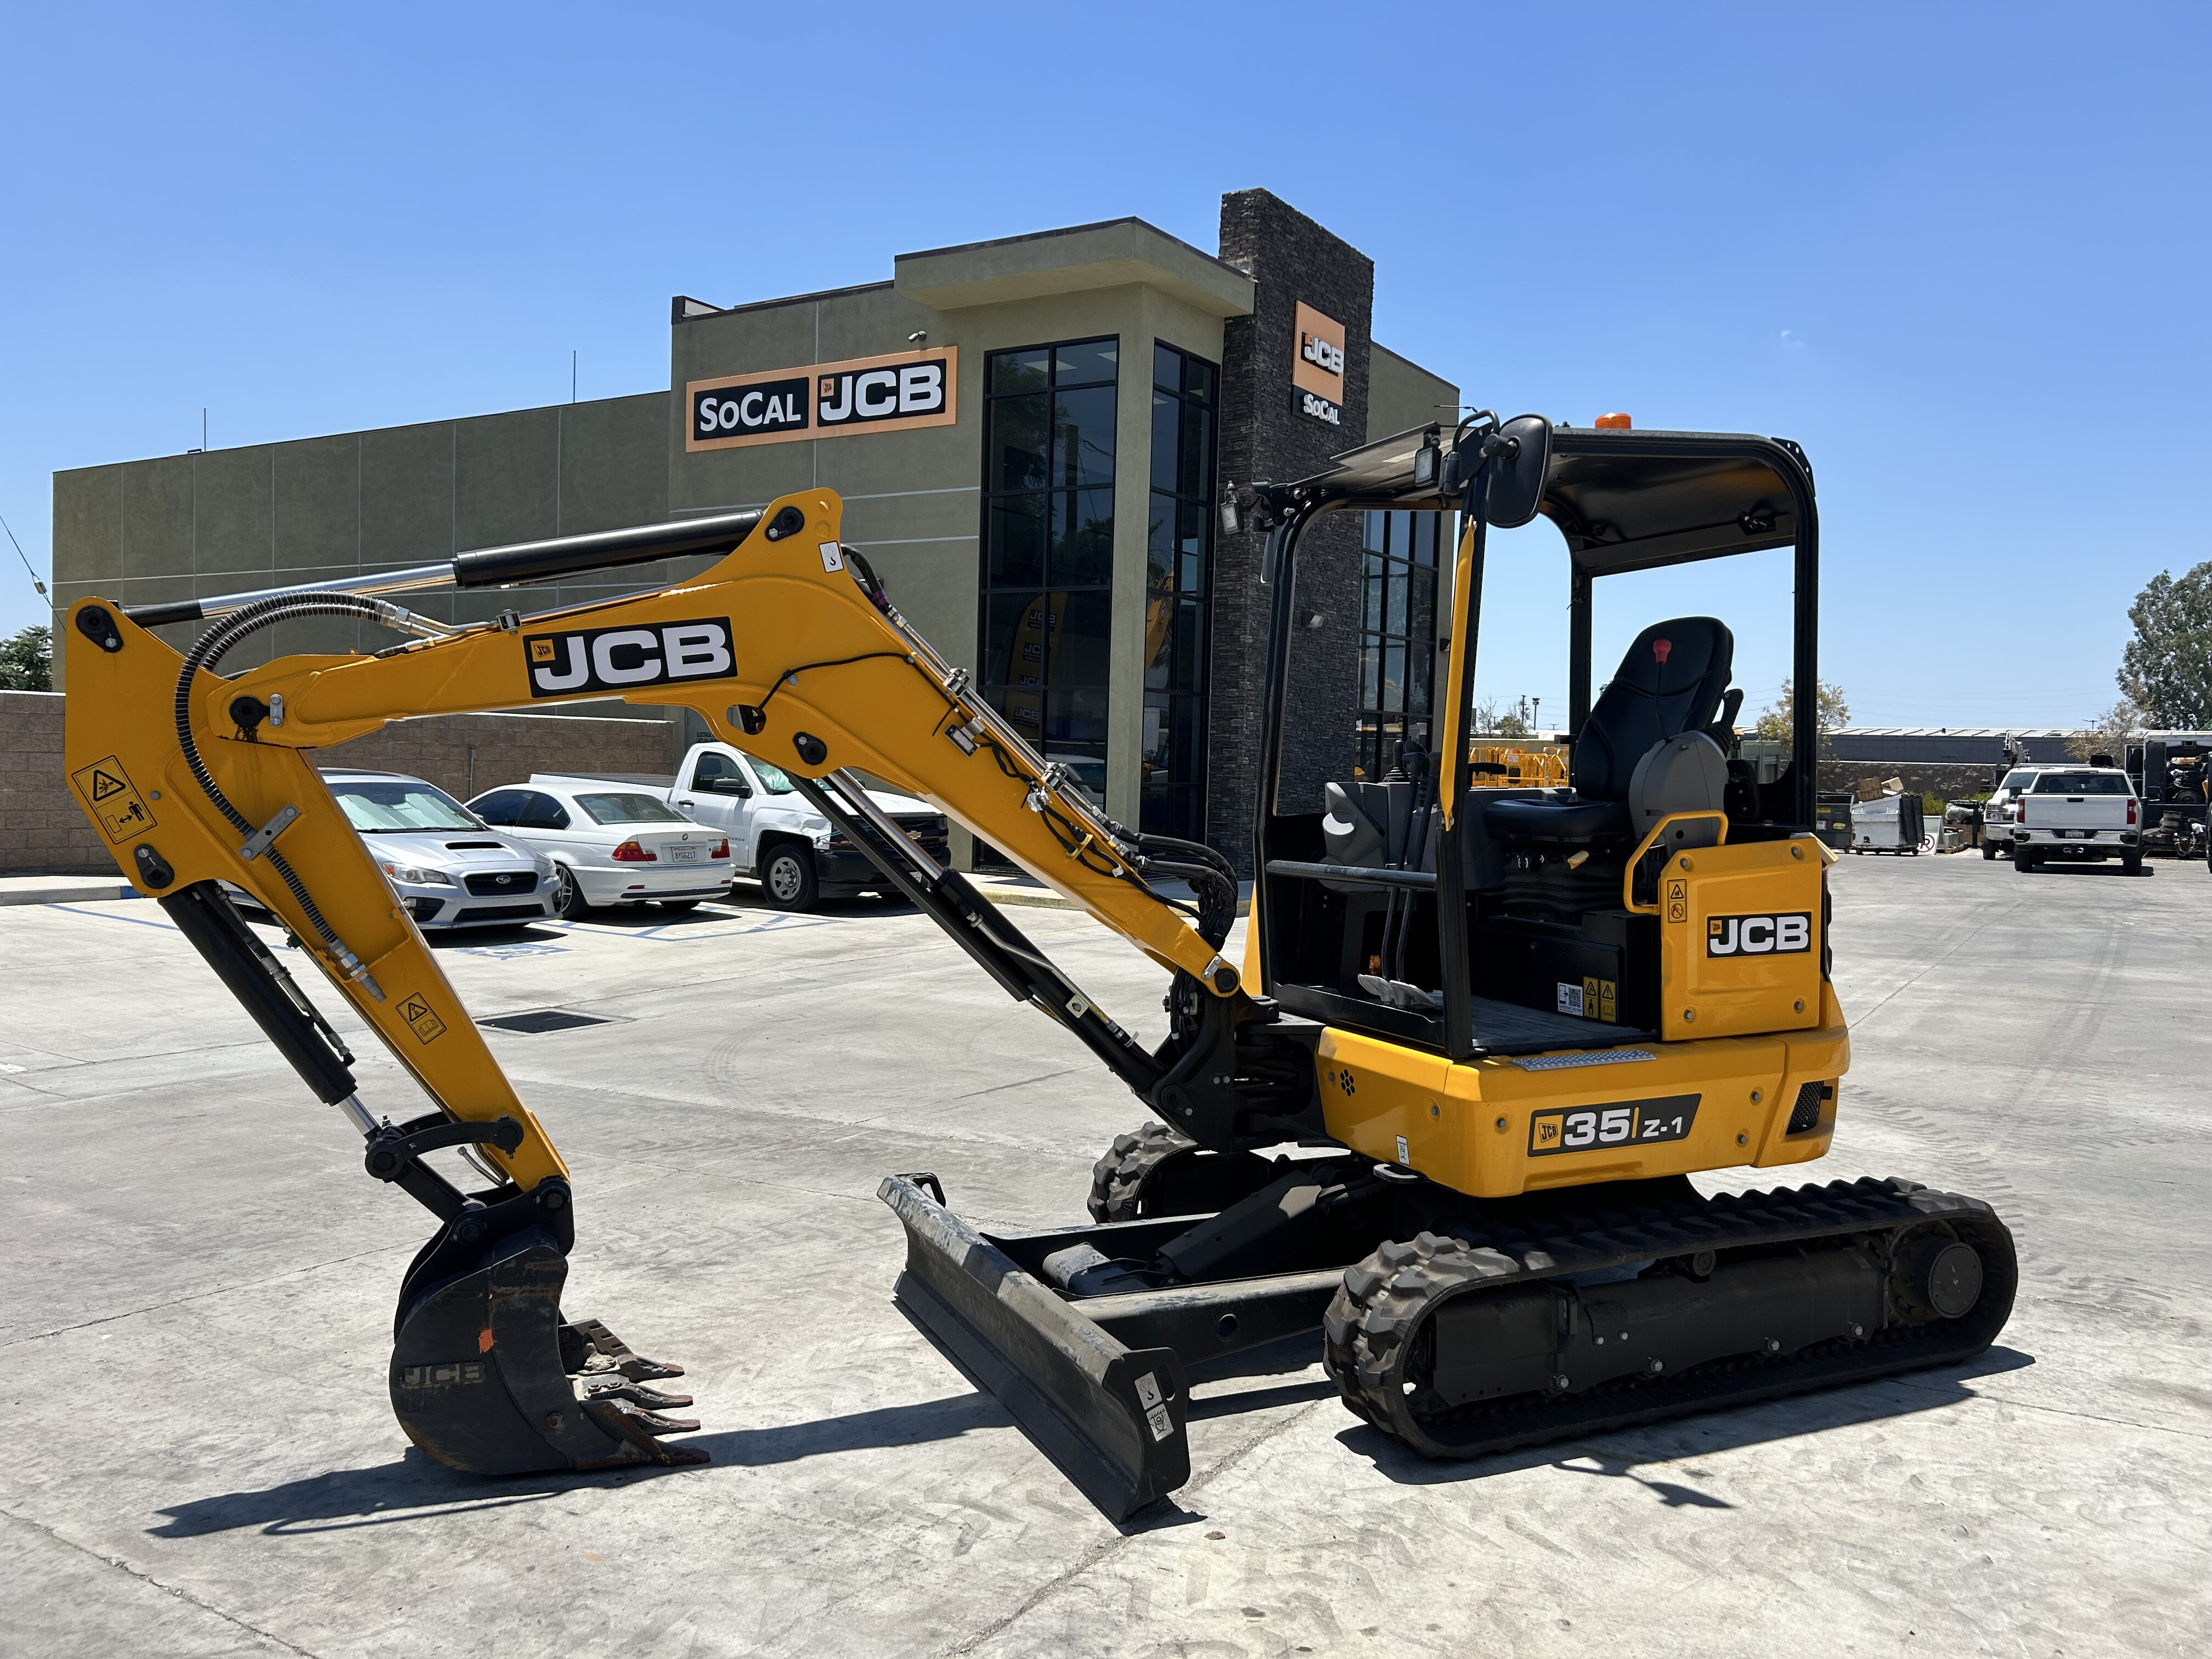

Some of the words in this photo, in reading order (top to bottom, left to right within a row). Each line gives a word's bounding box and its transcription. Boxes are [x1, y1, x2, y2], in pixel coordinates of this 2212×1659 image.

[1305, 337, 1344, 373] JCB
[820, 365, 942, 421] JCB
[534, 624, 731, 690] JCB
[537, 646, 551, 656] JCB
[1024, 644, 1041, 654] JC
[1710, 916, 1808, 954] JCB
[1542, 1125, 1557, 1141] JCB
[1564, 1108, 1631, 1147] 35
